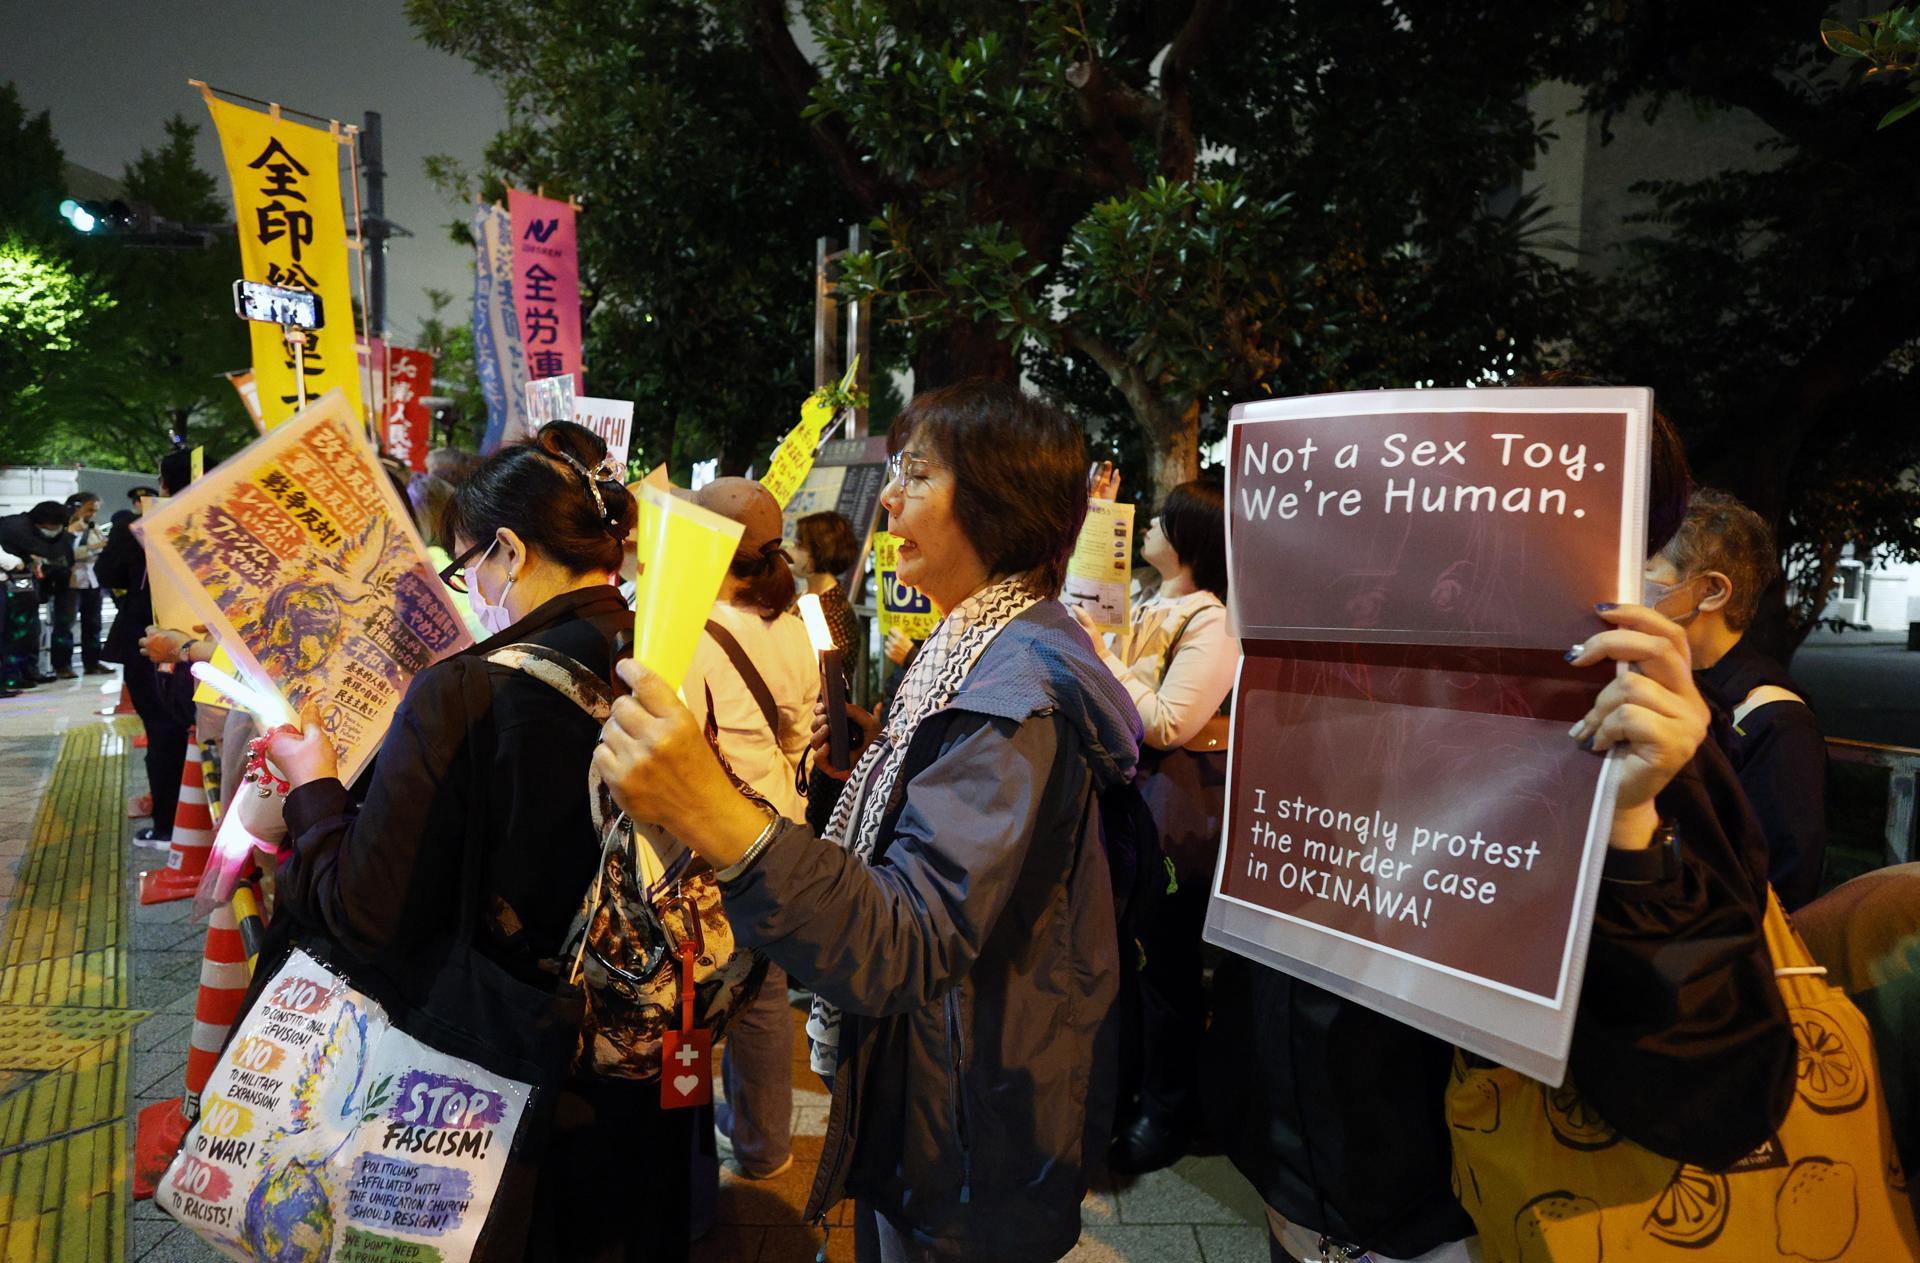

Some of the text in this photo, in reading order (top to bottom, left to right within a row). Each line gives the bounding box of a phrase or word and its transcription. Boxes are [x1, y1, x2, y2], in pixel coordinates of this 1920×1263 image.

[1243, 432, 1605, 483] Not a Sex Toy.
[241, 489, 299, 538] レイシスト
[260, 469, 342, 548] 戦争反対!
[1241, 479, 1586, 521] We're Human.
[211, 515, 270, 567] ファシズム
[242, 510, 298, 557] いらない!
[227, 549, 273, 585] やめろ!
[883, 576, 923, 608] NO!
[409, 609, 448, 649] やめろ!
[1254, 788, 1541, 872] I strongly protest
[1250, 821, 1497, 905] the murder case
[1247, 853, 1432, 928] in OKINAWA!
[262, 1005, 271, 1017] TO
[277, 980, 317, 1011] NO
[238, 1038, 273, 1068] NO
[227, 1084, 281, 1112] EXPANSION!
[228, 1068, 284, 1095] TO MILITARY
[200, 1101, 239, 1135] NO
[401, 1081, 491, 1129] STOP
[195, 1135, 256, 1169] TO WAR!
[382, 1122, 493, 1160] FASCISM!
[178, 1160, 212, 1195] NO
[356, 1175, 442, 1196] AFFILIATED WITH
[361, 1160, 420, 1179] POLITICIANS
[172, 1191, 234, 1228] TO RACISTS!
[349, 1190, 470, 1213] THE UNIFICATION CHURCH
[351, 1204, 449, 1232] SHOULD RESIGN!
[343, 1250, 352, 1261] A
[344, 1233, 361, 1247] WE
[392, 1243, 420, 1258] NEED
